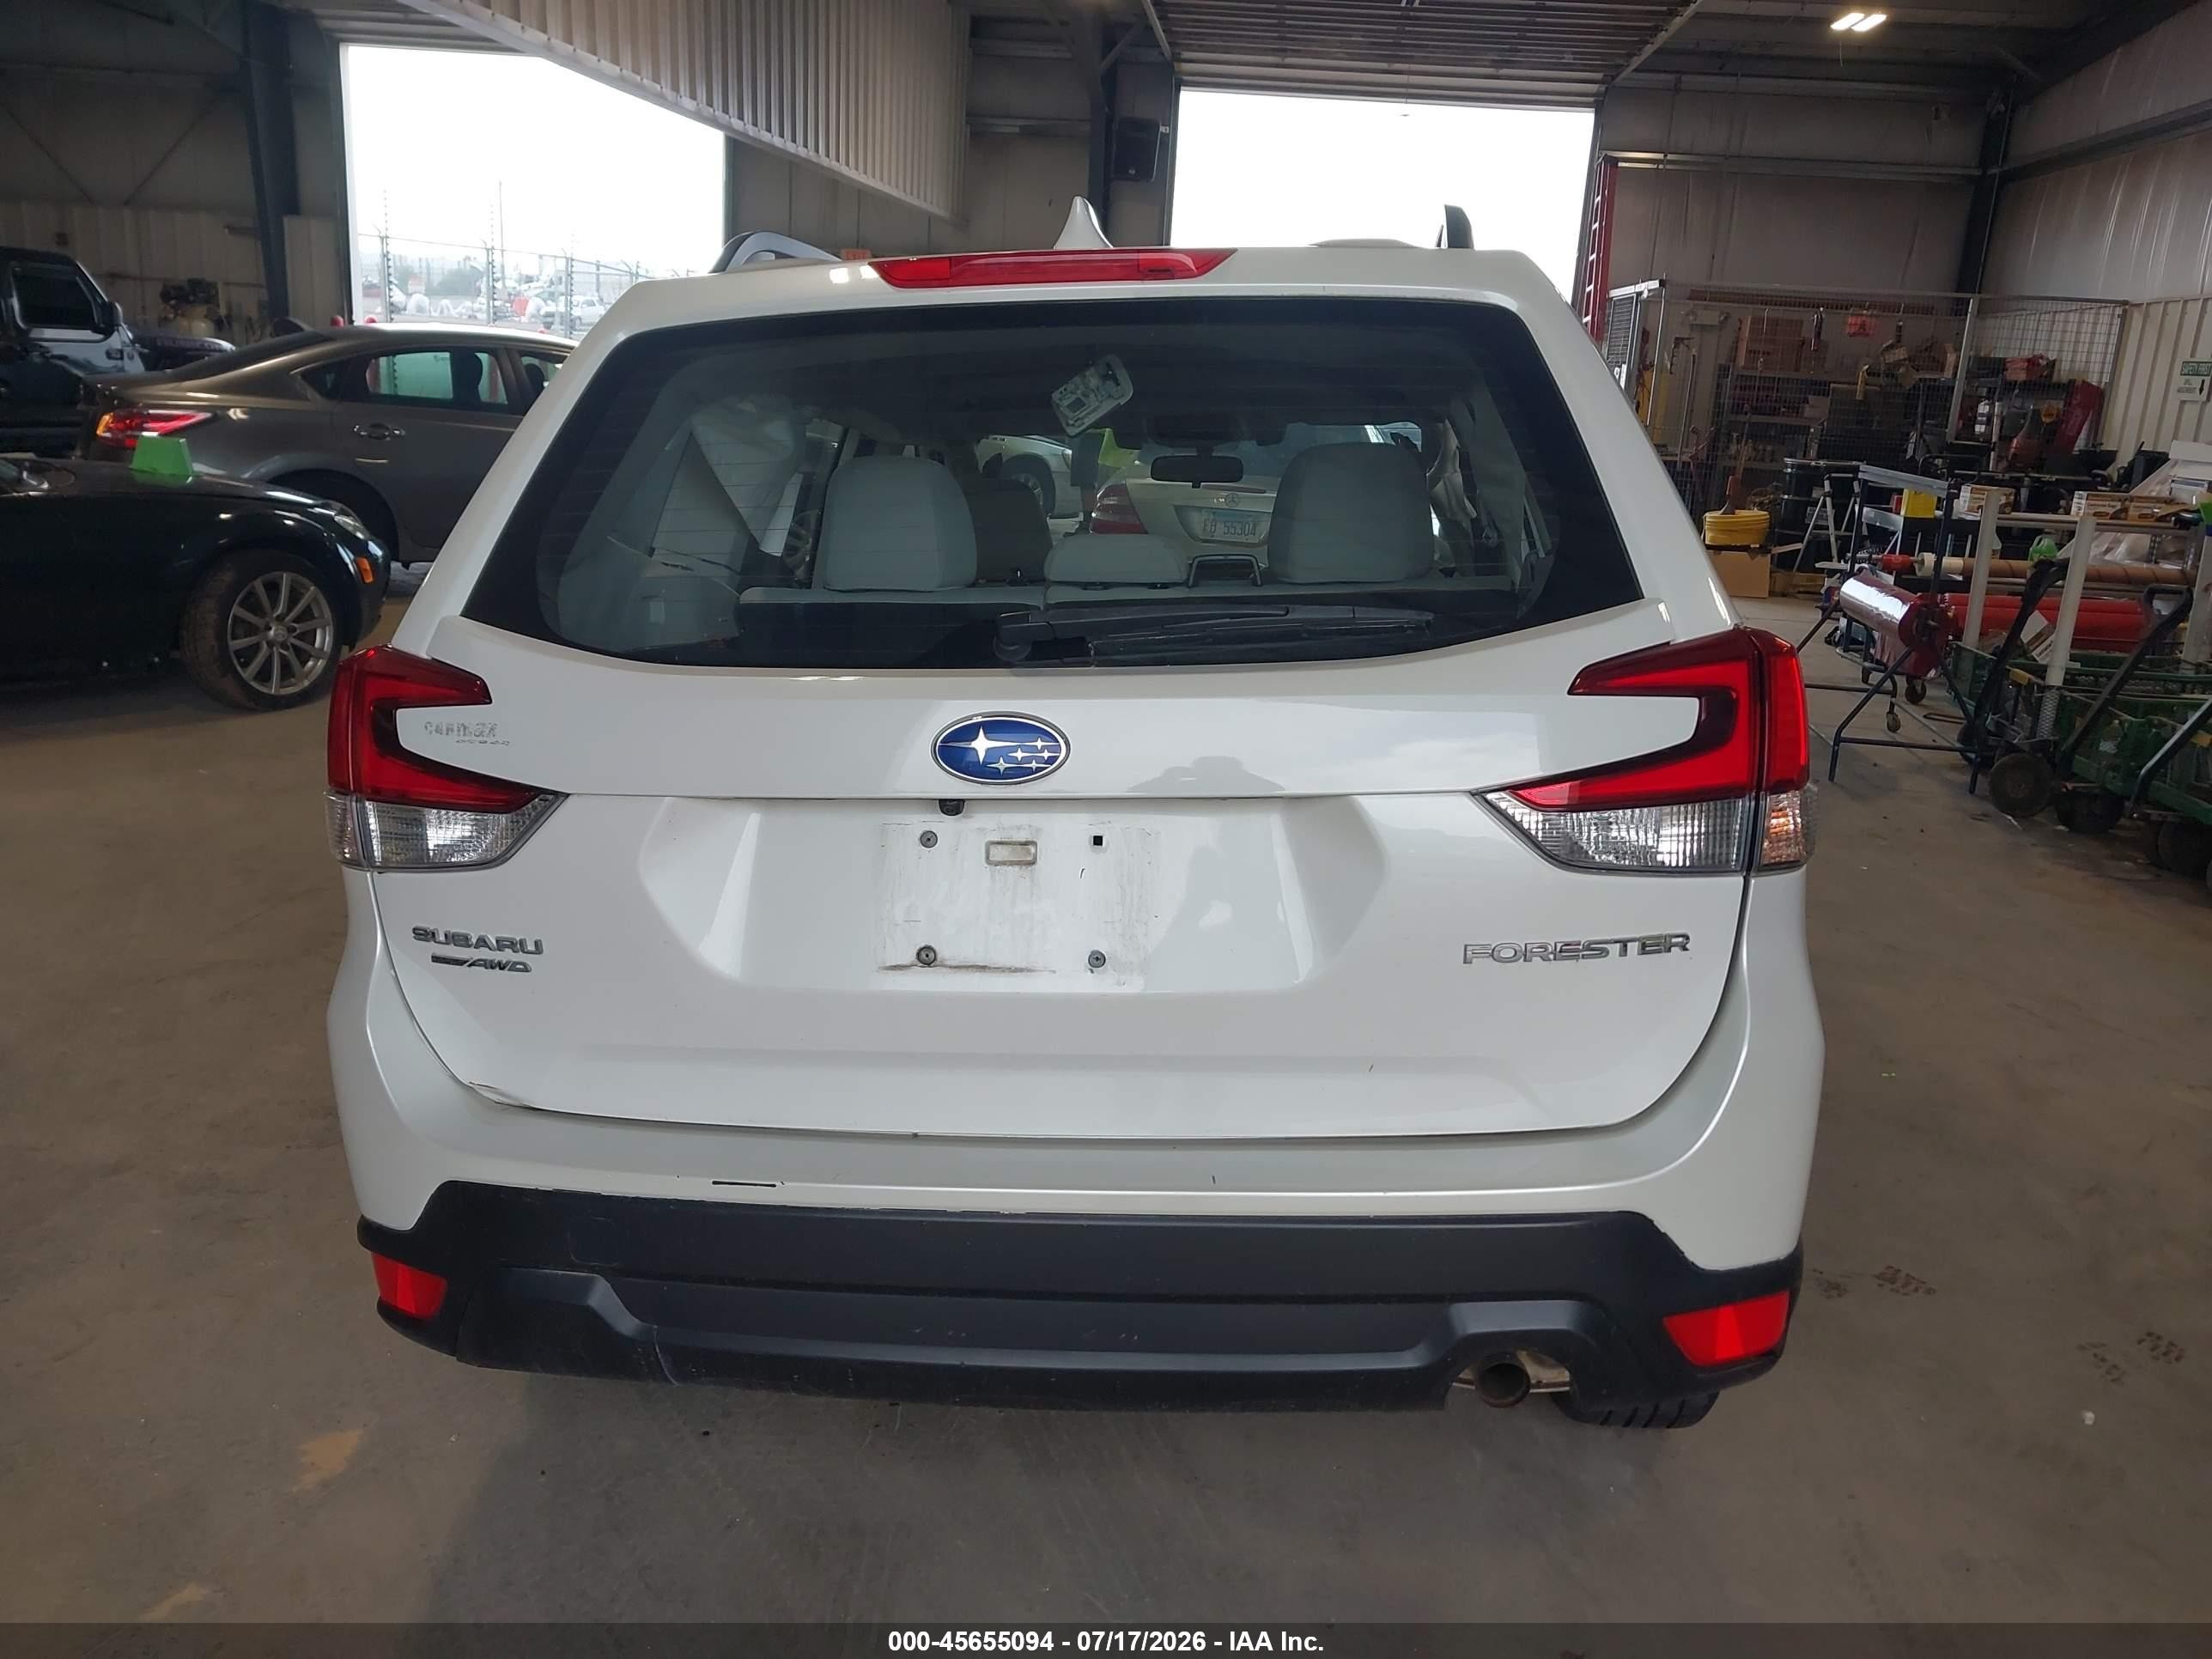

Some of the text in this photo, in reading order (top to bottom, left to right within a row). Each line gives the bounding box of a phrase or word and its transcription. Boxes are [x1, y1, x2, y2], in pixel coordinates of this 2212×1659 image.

[412, 925, 544, 955] SUBARU
[1462, 932, 1691, 964] FORESTER
[467, 957, 532, 973] AWD
